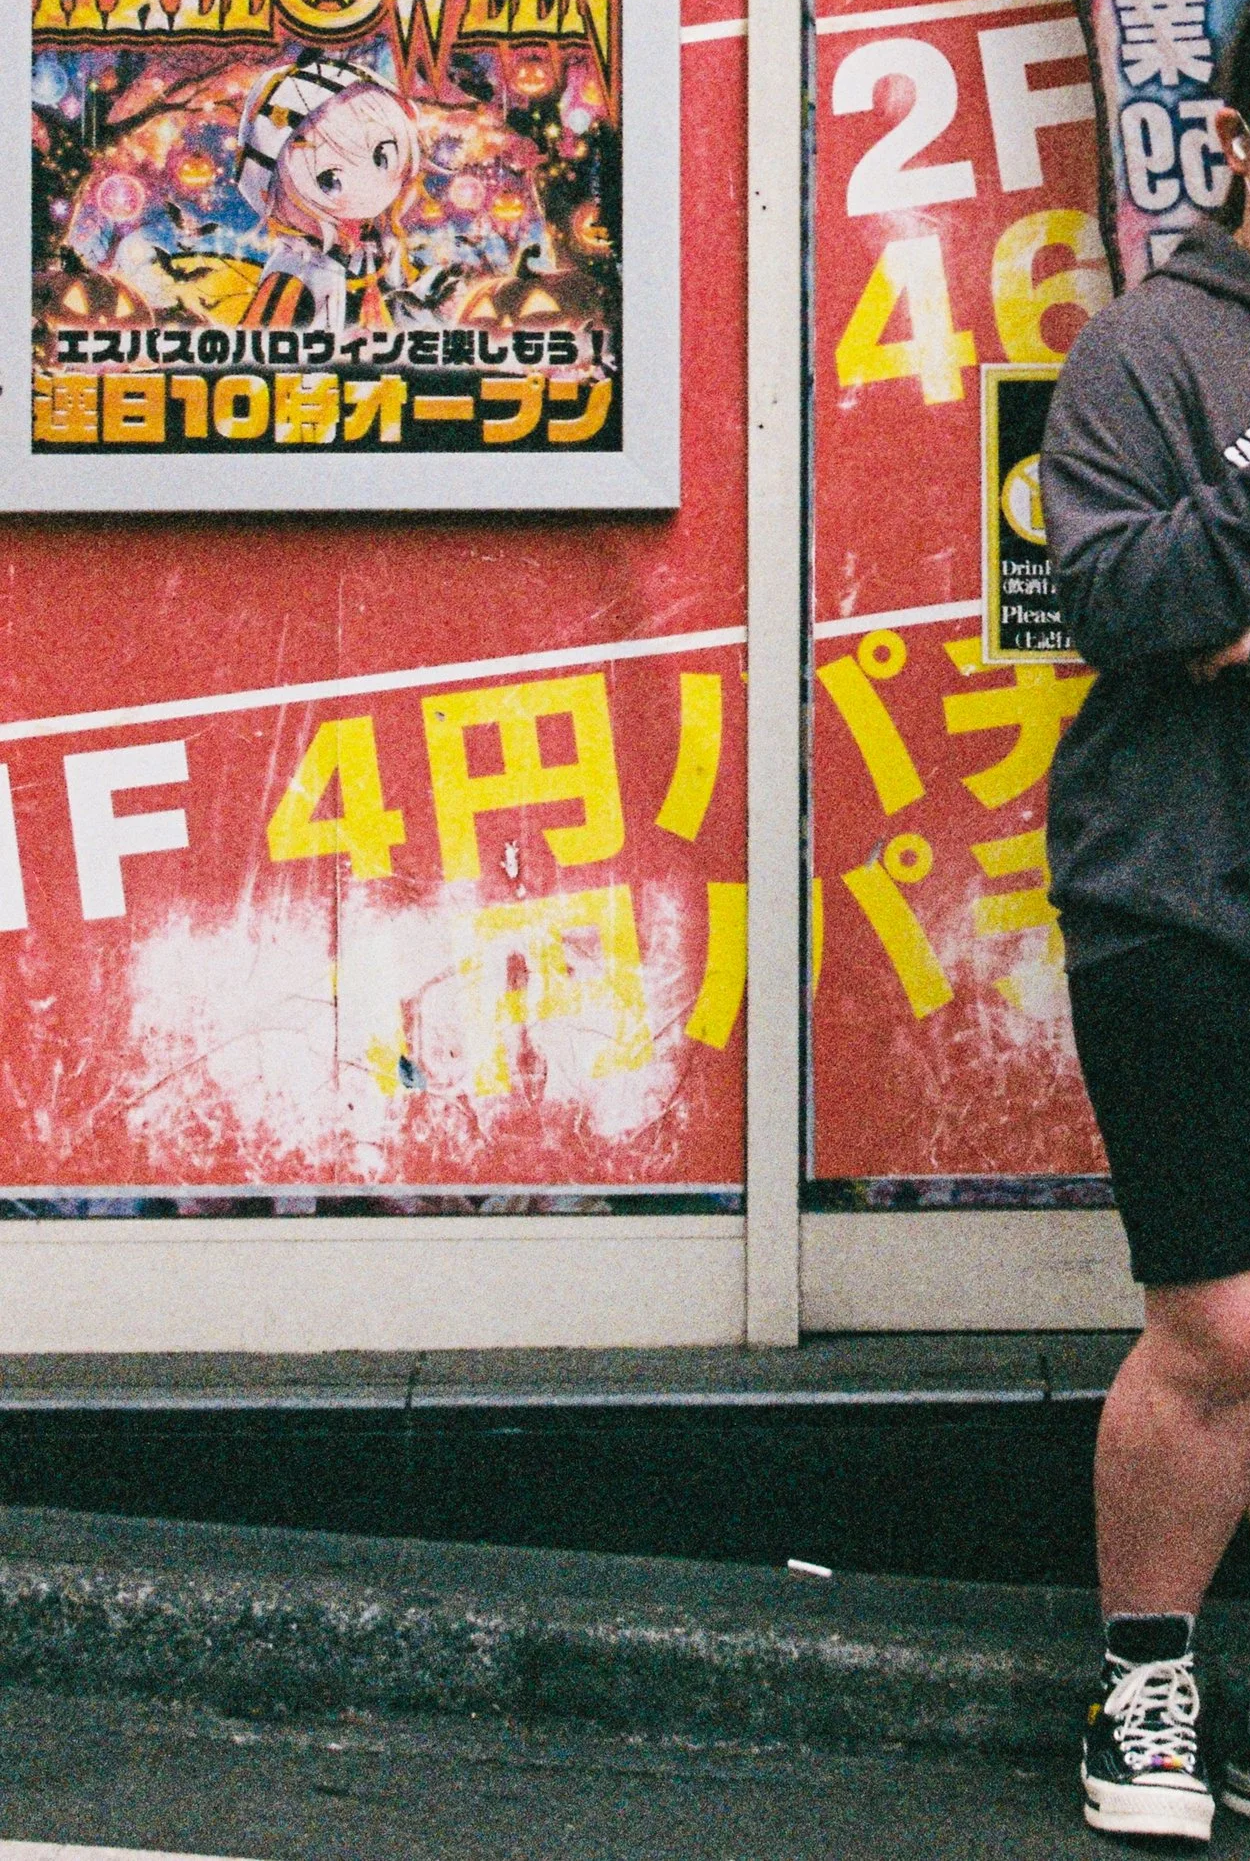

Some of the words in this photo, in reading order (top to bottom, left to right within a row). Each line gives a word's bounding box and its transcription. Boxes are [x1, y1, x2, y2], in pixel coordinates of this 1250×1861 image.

[831, 19, 1099, 218] 2F
[32, 372, 613, 444] 連日10時オープン
